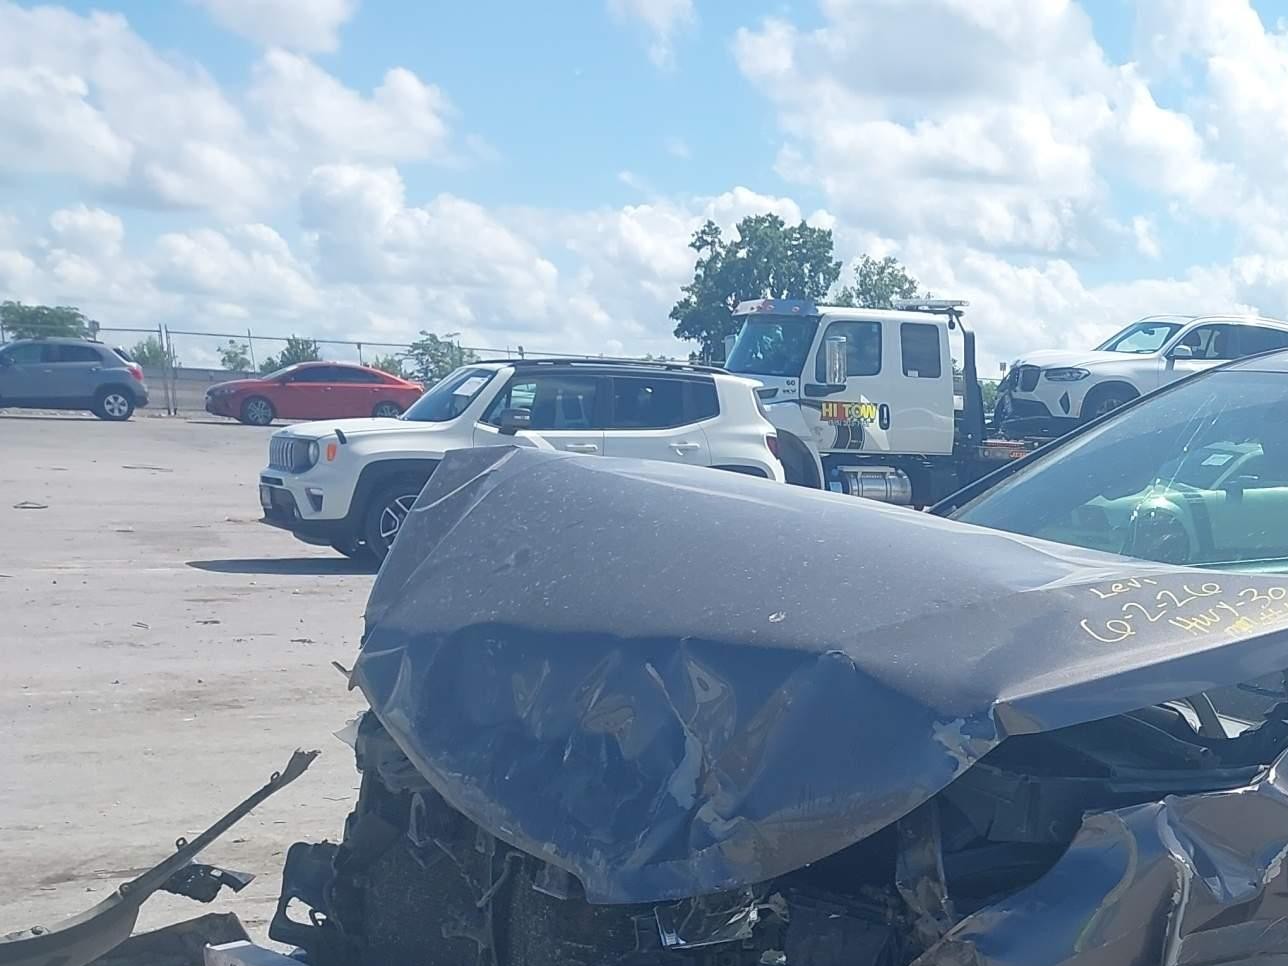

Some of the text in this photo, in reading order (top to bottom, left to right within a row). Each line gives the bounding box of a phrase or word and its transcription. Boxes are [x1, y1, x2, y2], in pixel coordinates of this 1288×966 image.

[821, 402, 877, 420] HI TOW
[1080, 582, 1222, 642] 6-2-26
